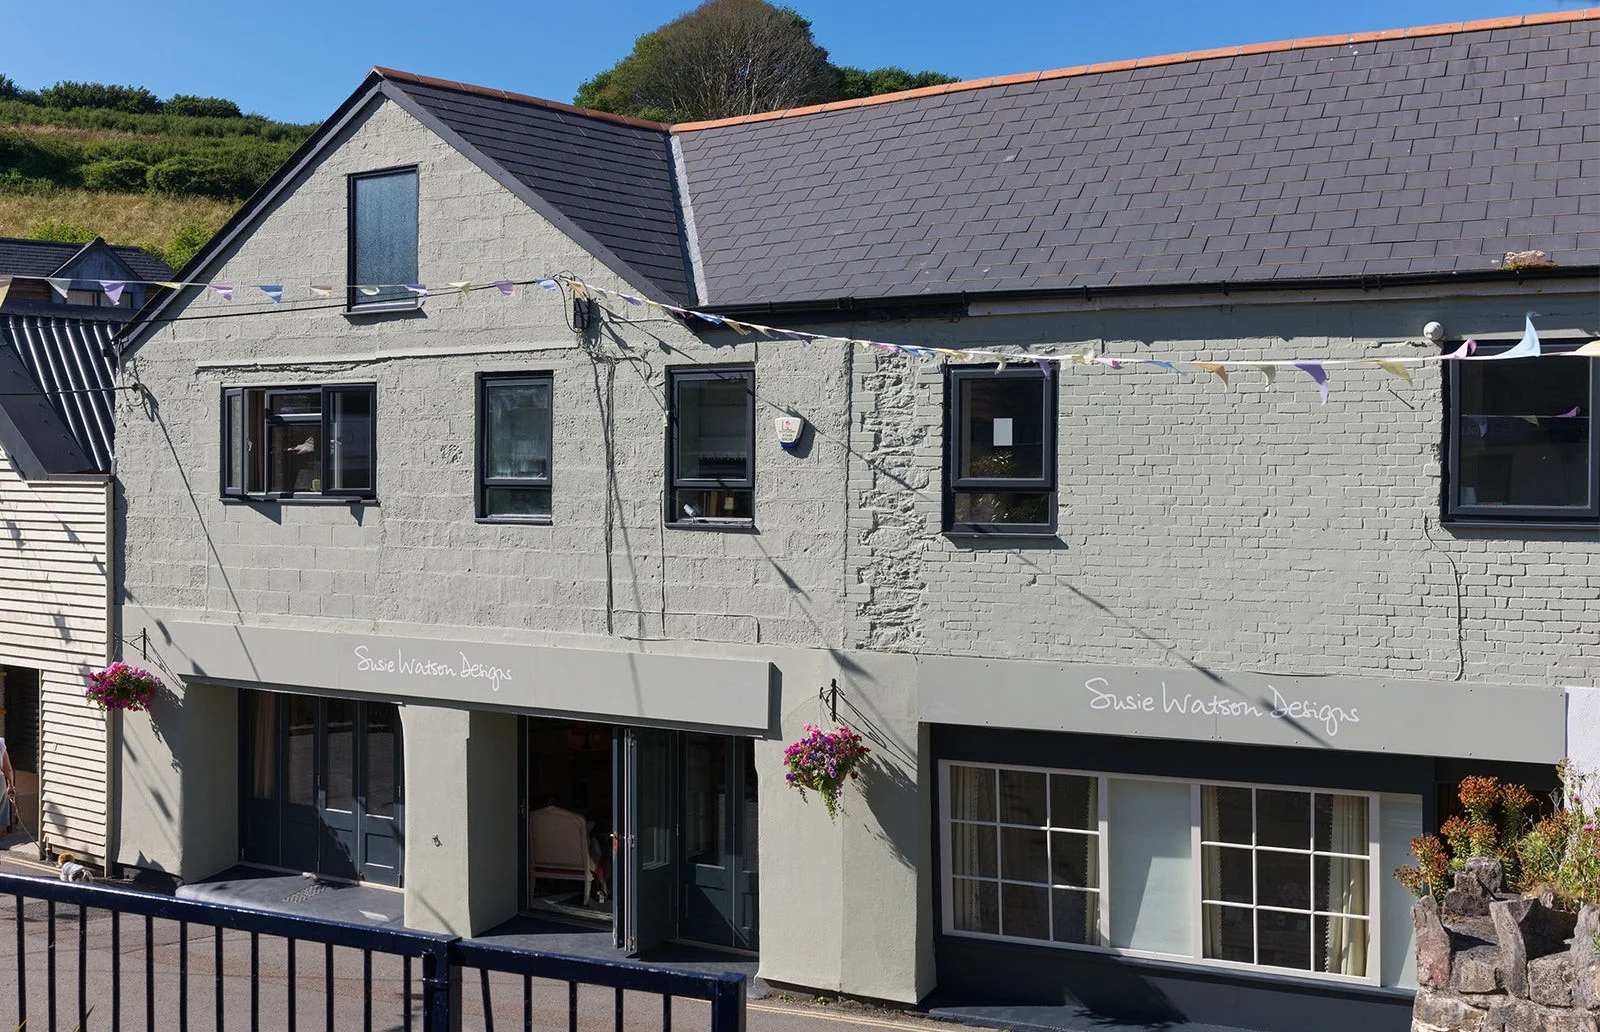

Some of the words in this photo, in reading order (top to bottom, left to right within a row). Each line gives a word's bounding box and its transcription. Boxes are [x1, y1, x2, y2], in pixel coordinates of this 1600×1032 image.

[354, 645, 395, 673] Susie
[398, 648, 456, 677] Watson
[459, 651, 513, 692] Designs
[1084, 677, 1155, 712] Susie
[1161, 681, 1264, 718] Watson
[1267, 685, 1361, 736] Designs
